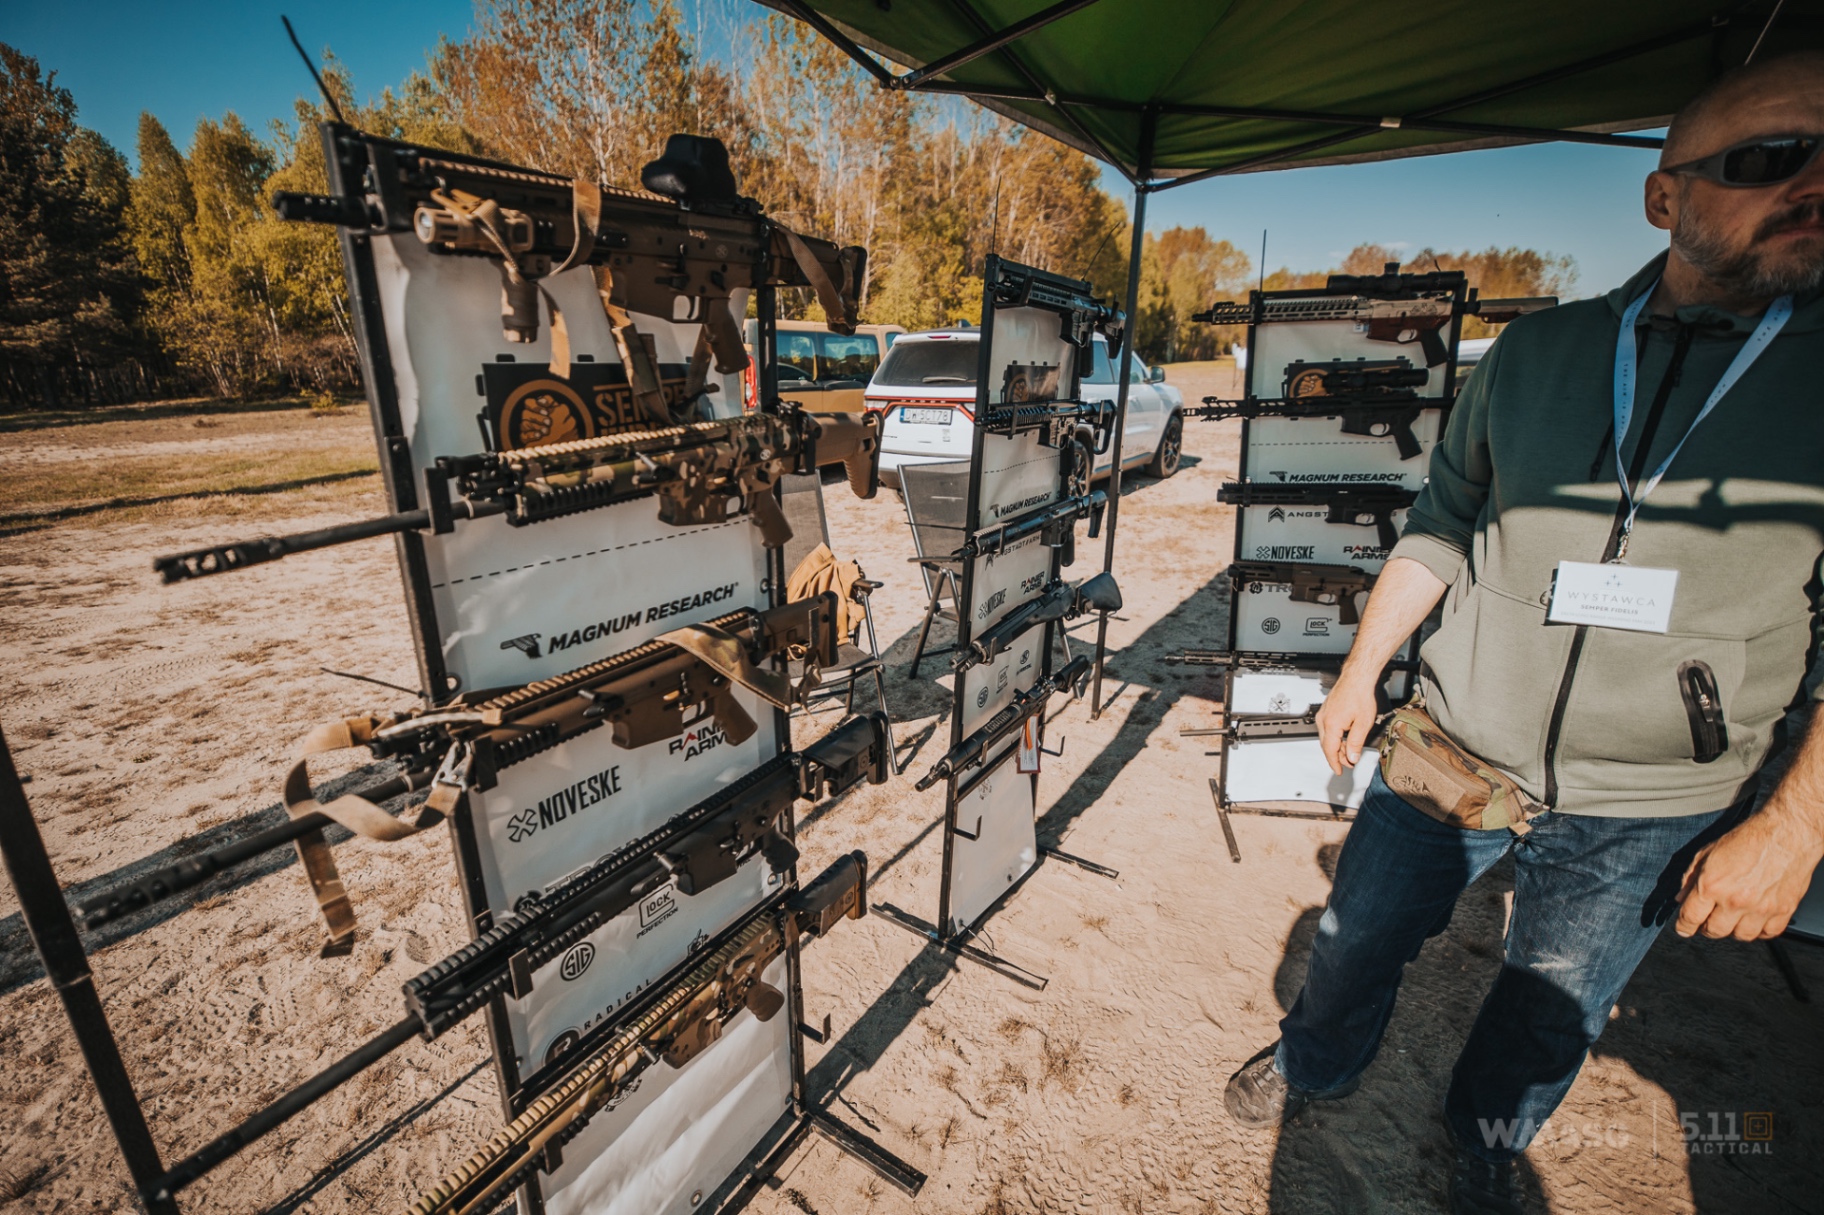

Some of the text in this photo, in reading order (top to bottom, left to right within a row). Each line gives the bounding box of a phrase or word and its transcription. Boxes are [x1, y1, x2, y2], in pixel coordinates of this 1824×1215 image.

[1289, 473, 1404, 482] MAGNUM RESEARCH
[1000, 492, 1051, 516] MAGNUM RESEARCH
[1271, 546, 1315, 559] NOVESKE
[1568, 591, 1656, 607] WYSTAWCA
[1580, 604, 1639, 615] SEMPER FIDELIS
[548, 583, 735, 654] MAGNUM RESEARCH
[1263, 618, 1279, 633] SIG
[684, 731, 728, 762] ARM
[538, 765, 622, 830] NOVESKE
[636, 907, 679, 939] PERFECTION
[562, 944, 593, 979] SIG
[584, 979, 652, 1031] RADICAL
